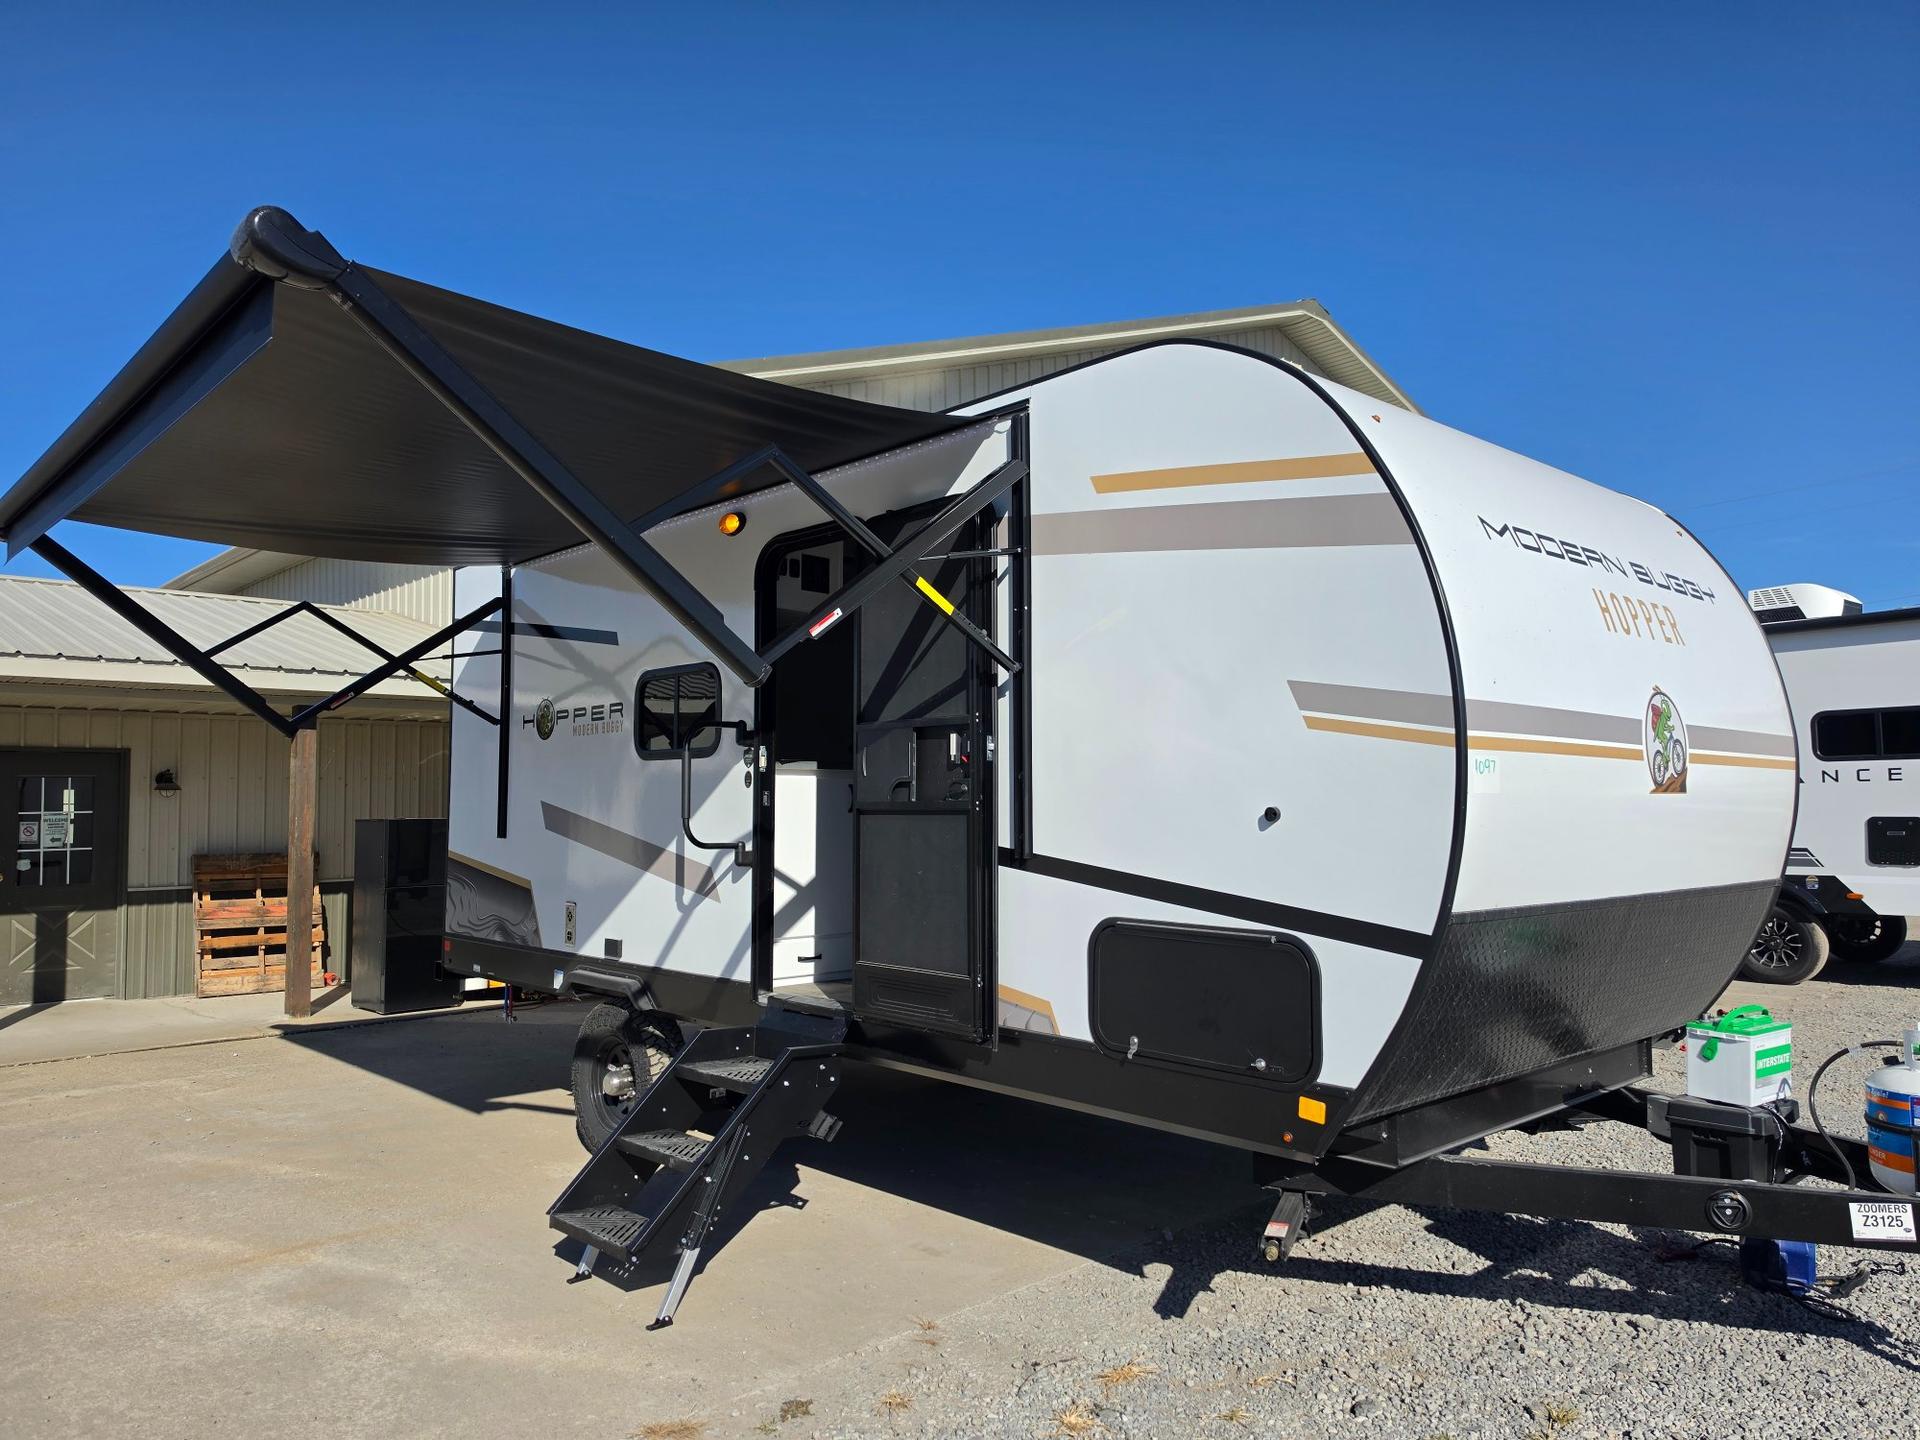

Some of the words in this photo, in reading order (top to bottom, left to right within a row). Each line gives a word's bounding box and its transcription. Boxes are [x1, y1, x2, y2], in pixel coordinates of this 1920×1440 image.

[1477, 515, 1629, 578] MODERN
[1628, 561, 1716, 604] BUGGY
[1592, 588, 1686, 646] HOPPER
[572, 724, 599, 737] MODERN
[601, 720, 624, 734] BUGGY
[1475, 759, 1496, 774] 1097
[1799, 768, 1903, 784] NCE
[1756, 1053, 1791, 1070] INTERSTATE
[1857, 1204, 1908, 1213] ZOOMERS
[1862, 1215, 1904, 1228] Z3125
